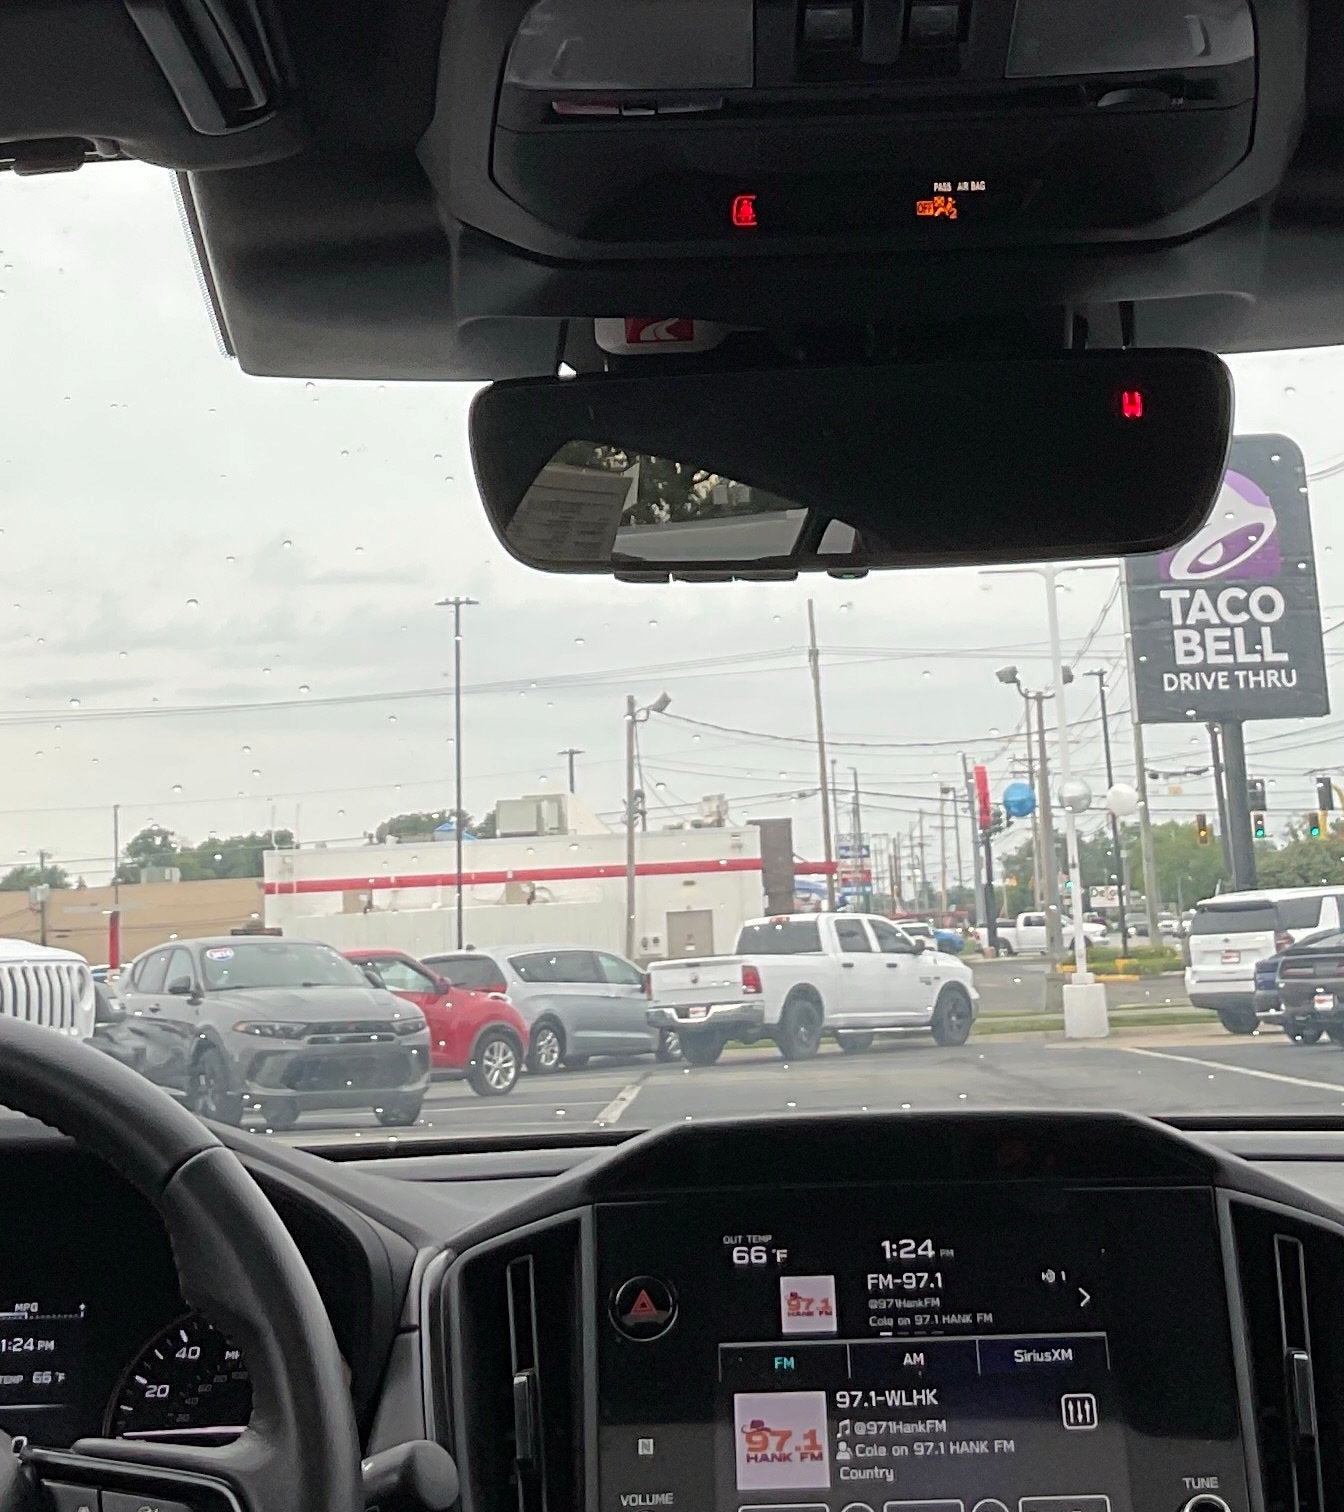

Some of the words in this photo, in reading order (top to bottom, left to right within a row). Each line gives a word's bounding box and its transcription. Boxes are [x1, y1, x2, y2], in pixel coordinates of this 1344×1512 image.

[934, 182, 952, 192] PASS
[957, 181, 969, 191] AIR
[970, 180, 986, 191] BAG
[918, 202, 933, 214] OFF
[1160, 585, 1285, 626] TACO
[1173, 626, 1289, 665] BELL
[1163, 671, 1230, 692] DRIVE
[1234, 669, 1297, 689] THRU
[723, 1236, 743, 1245] OUT
[746, 1234, 773, 1244] TEMP
[732, 1246, 767, 1265] 66
[881, 1238, 936, 1259] 1:24
[940, 1248, 955, 1258] PM
[867, 1272, 944, 1290] FM-97.1
[14, 1302, 39, 1313] MPG
[787, 1296, 833, 1312] 97.1
[868, 1297, 941, 1310] @971HankFM
[898, 1317, 911, 1326] on
[914, 1314, 940, 1326] 97.1
[942, 1314, 973, 1324] HANK
[976, 1312, 993, 1323] FM
[0, 1337, 35, 1352] 1:24
[37, 1339, 55, 1351] PM
[175, 1346, 201, 1360] 40
[903, 1353, 925, 1366] AM
[1014, 1348, 1073, 1363] SiriusXM
[774, 1356, 796, 1369] FM
[32, 1371, 52, 1384] 66
[145, 1384, 170, 1398] 20
[835, 1389, 939, 1408] 97.1-WLHK
[855, 1420, 947, 1435] @971HankFM
[745, 1428, 823, 1453] 97.1
[855, 1443, 887, 1457] Cole
[892, 1445, 908, 1456] on
[914, 1441, 946, 1455] 97.1
[949, 1440, 989, 1454] HANK
[994, 1439, 1015, 1453] FM
[746, 1451, 793, 1463] HANK
[800, 1450, 823, 1462] FM
[839, 1466, 894, 1482] Country
[1182, 1477, 1218, 1489] TUNE
[620, 1493, 674, 1506] VOLUME
